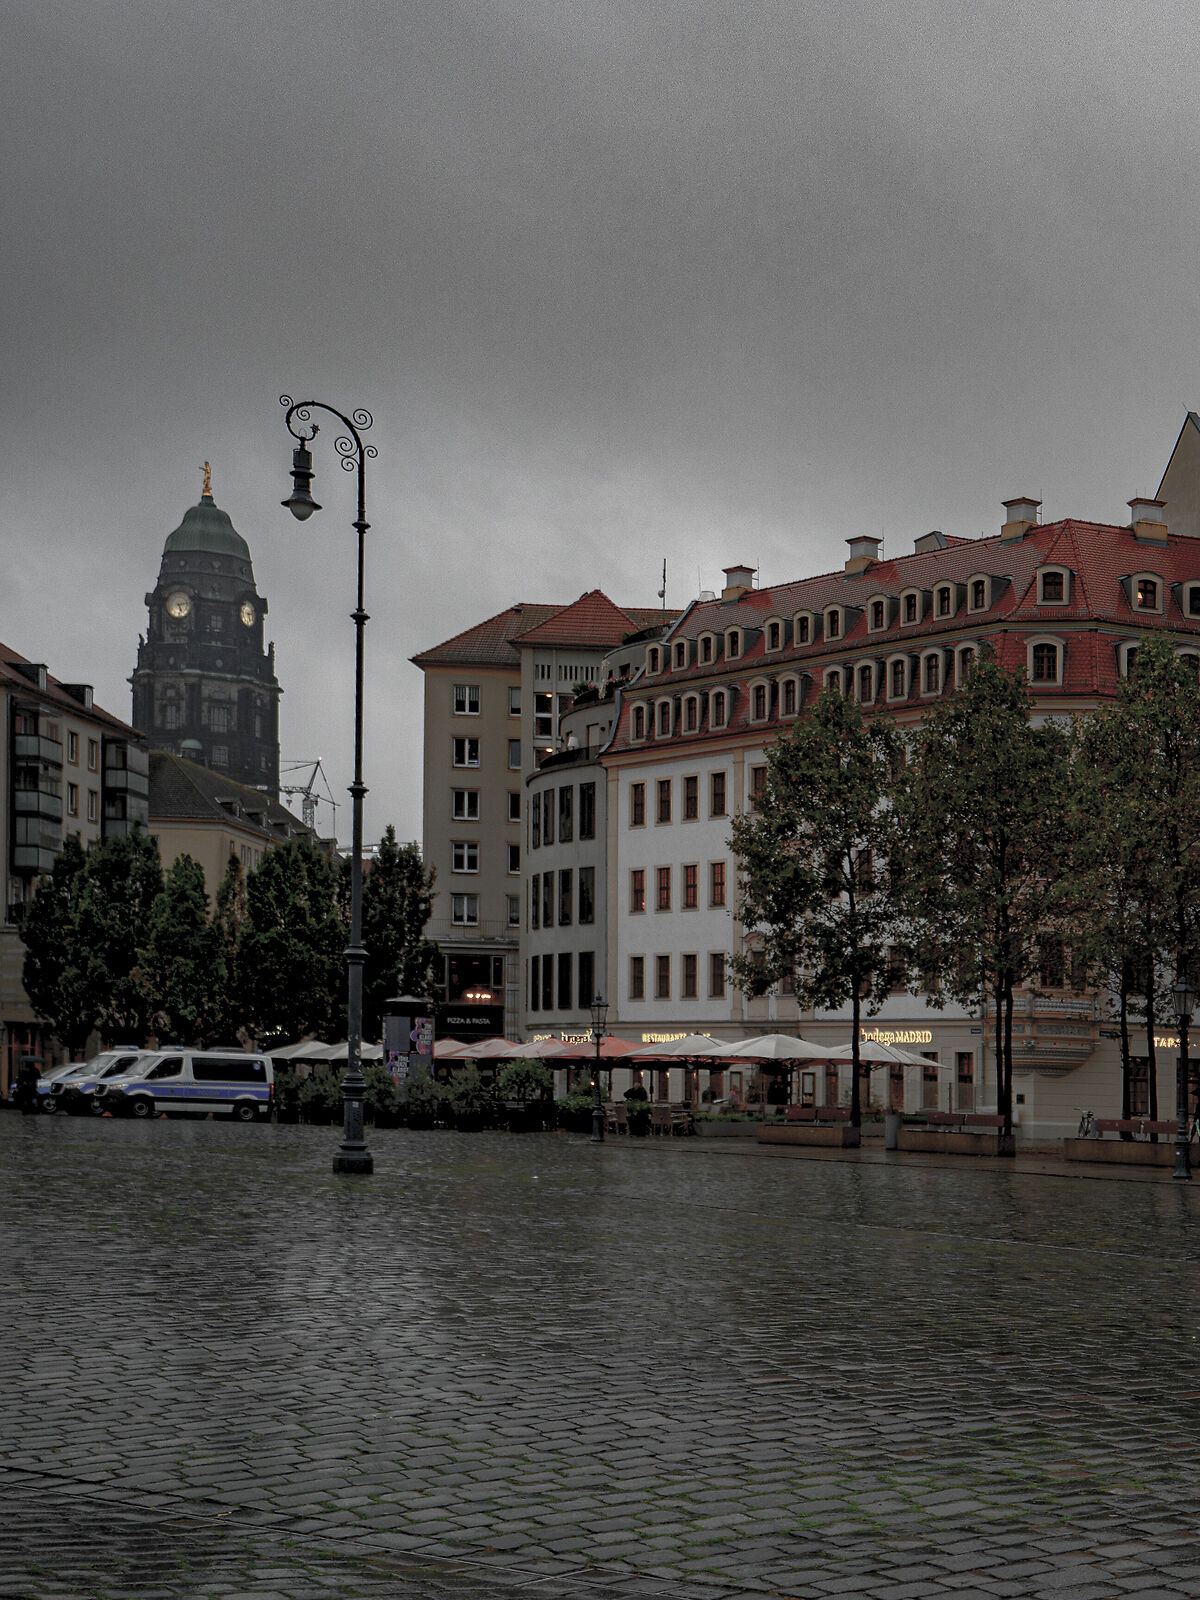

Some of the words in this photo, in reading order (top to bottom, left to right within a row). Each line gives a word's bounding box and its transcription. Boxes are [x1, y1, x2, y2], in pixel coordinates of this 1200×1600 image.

[861, 1027, 895, 1046] bodega
[895, 1030, 933, 1043] MADRID
[1153, 1036, 1190, 1048] TAPA
